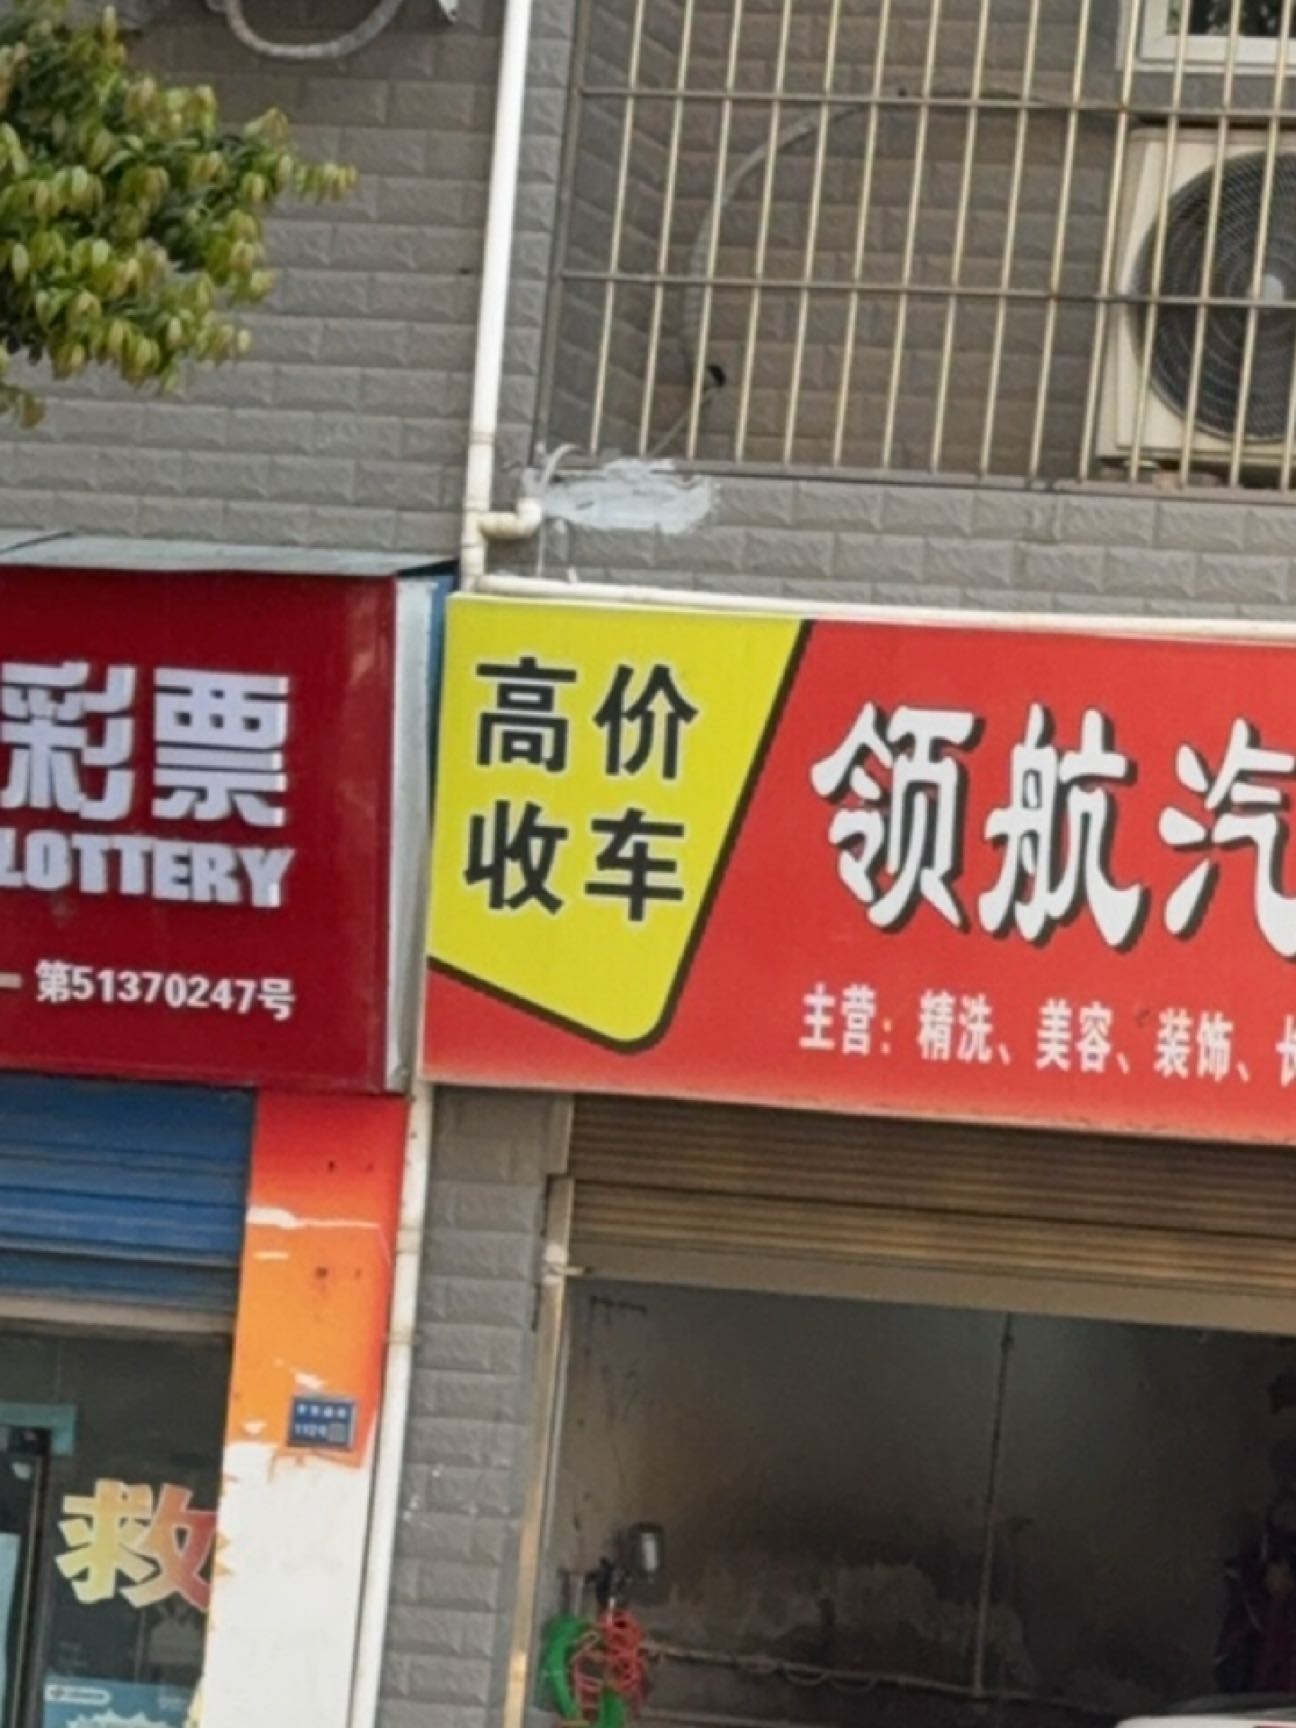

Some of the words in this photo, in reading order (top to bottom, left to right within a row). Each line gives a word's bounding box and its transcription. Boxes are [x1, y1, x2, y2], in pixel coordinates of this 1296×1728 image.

[0, 661, 289, 827] 彩票
[475, 656, 698, 780] 高价
[0, 827, 295, 907] LOTTERY
[463, 800, 685, 922] 收车
[35, 958, 295, 1020] 第51370247号
